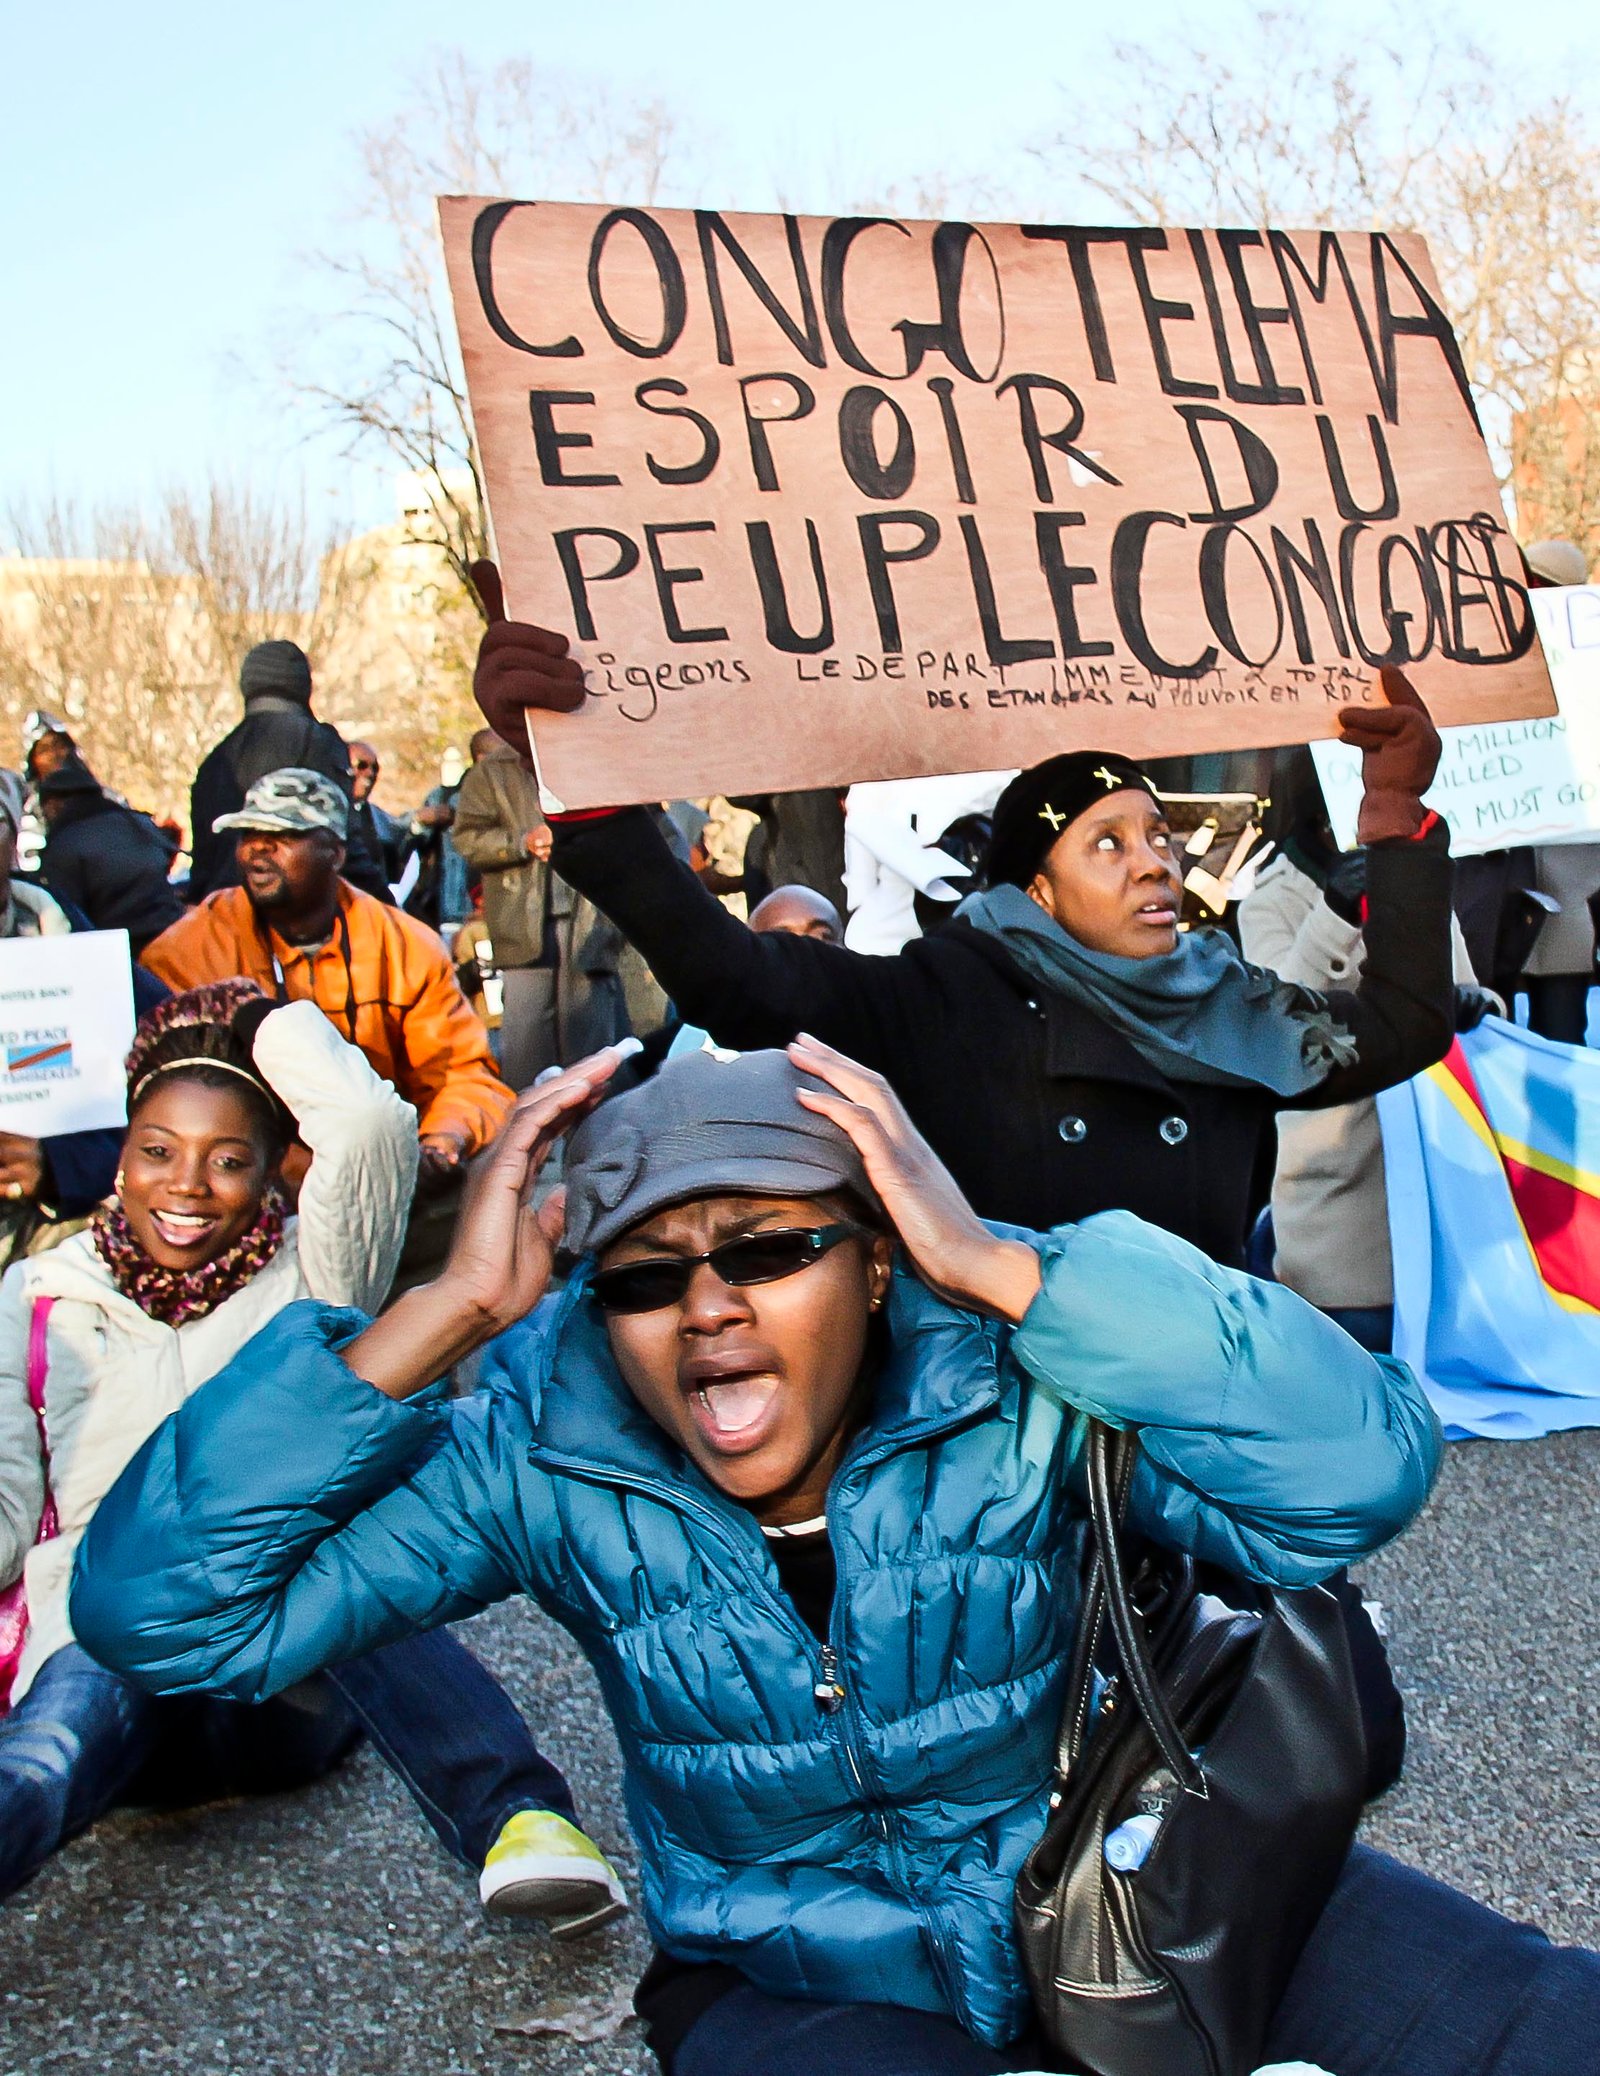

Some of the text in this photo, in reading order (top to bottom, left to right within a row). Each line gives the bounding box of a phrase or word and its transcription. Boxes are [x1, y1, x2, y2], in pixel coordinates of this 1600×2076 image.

[471, 200, 1486, 438] CONGO TELEMA
[528, 371, 1400, 524] ESPOIR DU
[551, 509, 1115, 667] PEUPLE
[796, 657, 840, 682] LE
[1285, 665, 1373, 688] TOTAL
[926, 688, 971, 710] DES
[1321, 683, 1374, 703] RDC
[1456, 715, 1567, 757] MILLION
[1475, 783, 1544, 830] MUST
[1557, 782, 1598, 807] GO
